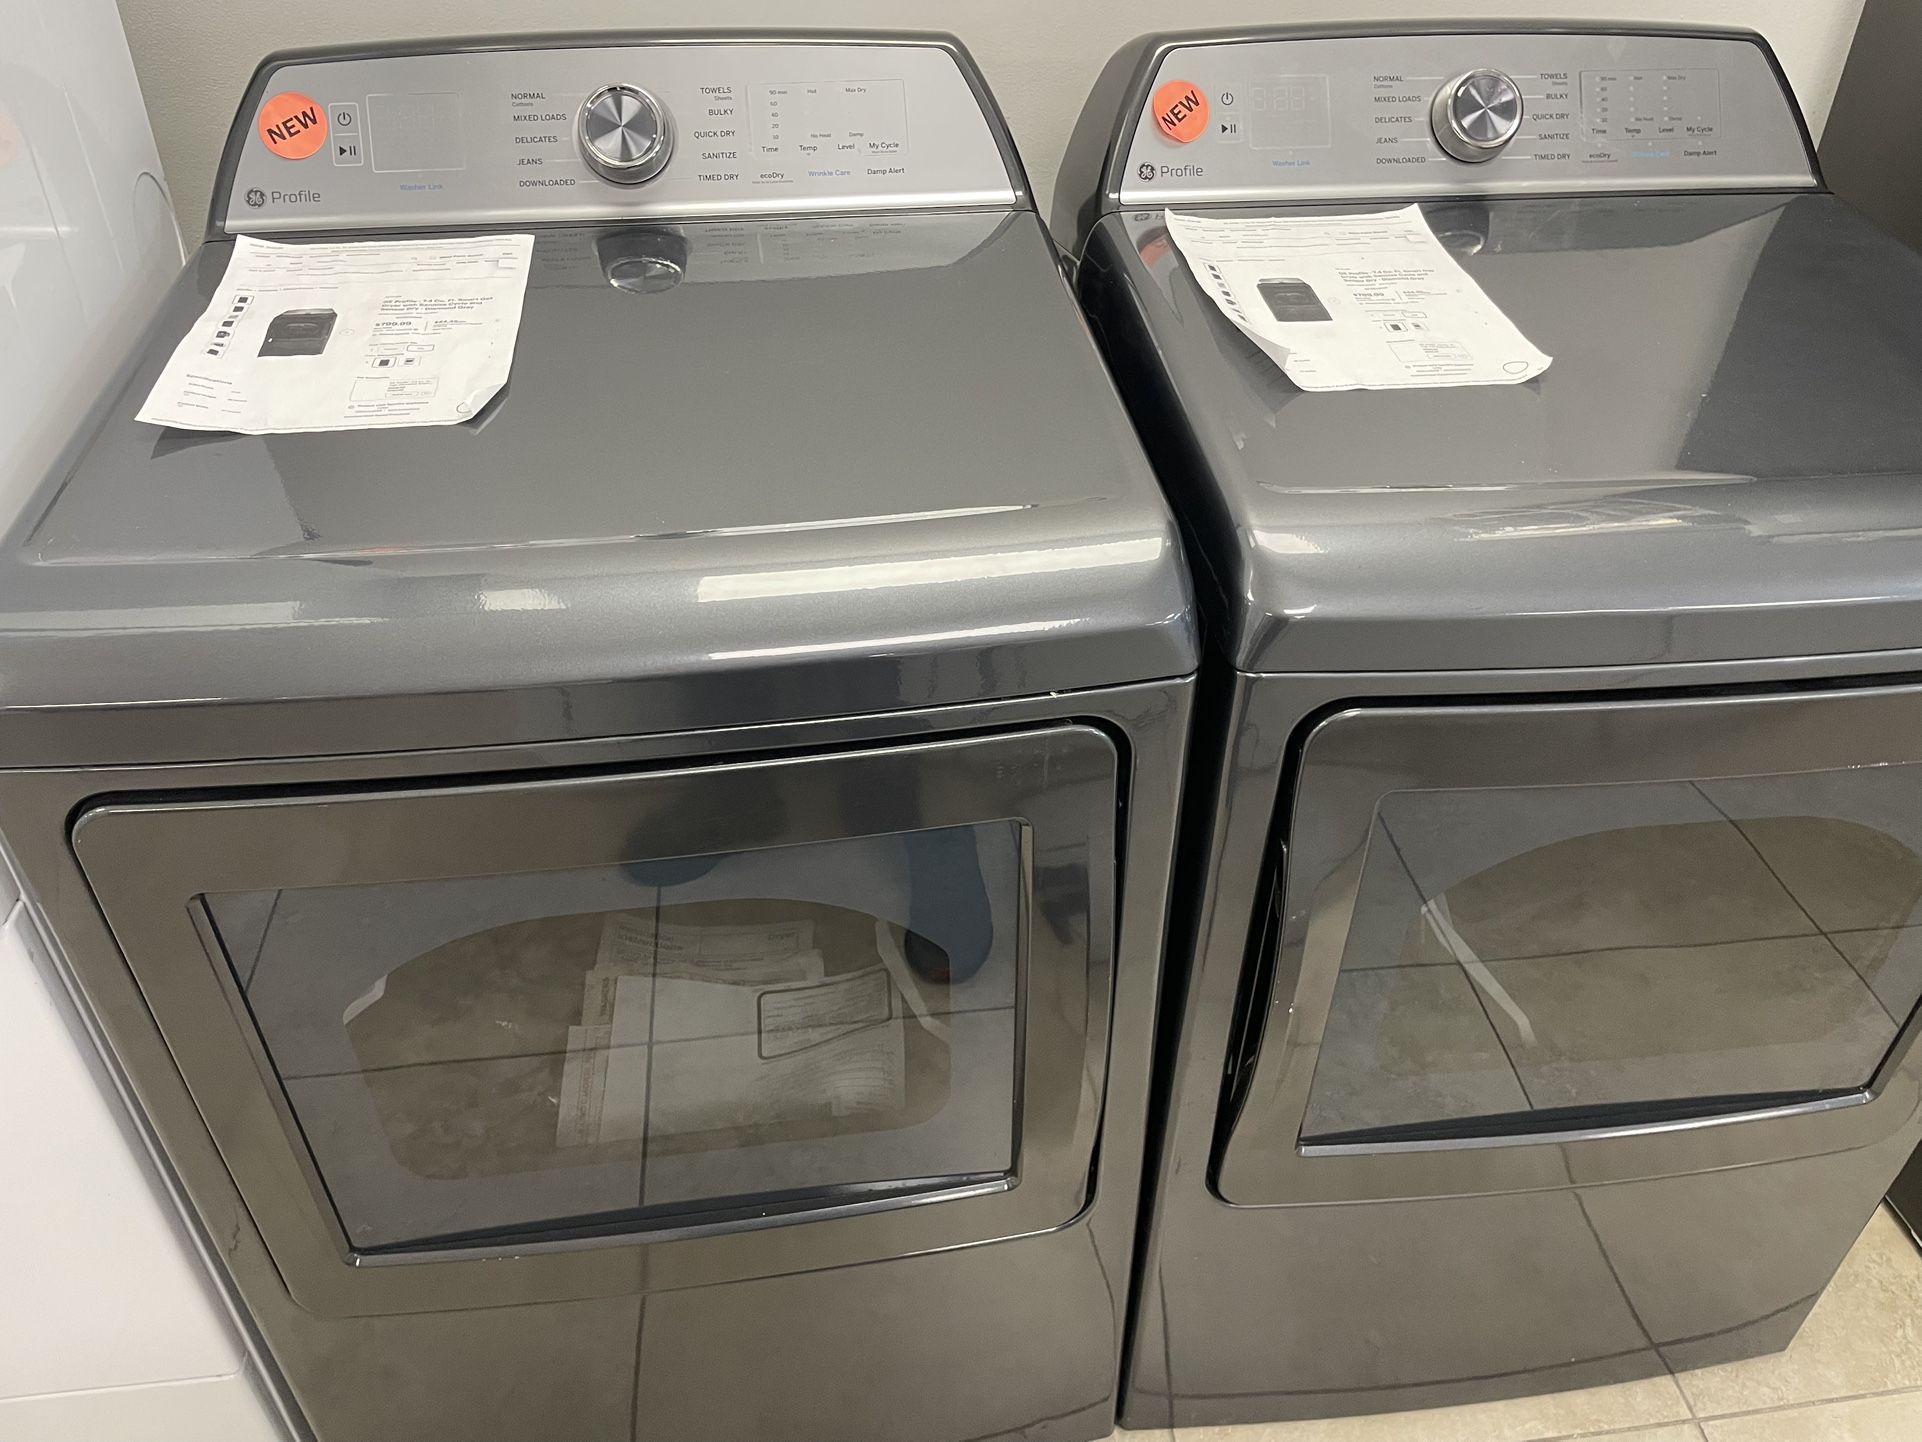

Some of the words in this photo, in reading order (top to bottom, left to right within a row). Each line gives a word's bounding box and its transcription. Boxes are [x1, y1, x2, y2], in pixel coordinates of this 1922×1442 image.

[1162, 90, 1200, 131] NEW
[266, 107, 318, 144] NEW
[694, 131, 718, 139] QUICK
[1160, 165, 1203, 178] Profile
[519, 179, 575, 187] DOWNLOADED
[272, 190, 320, 204] Profile
